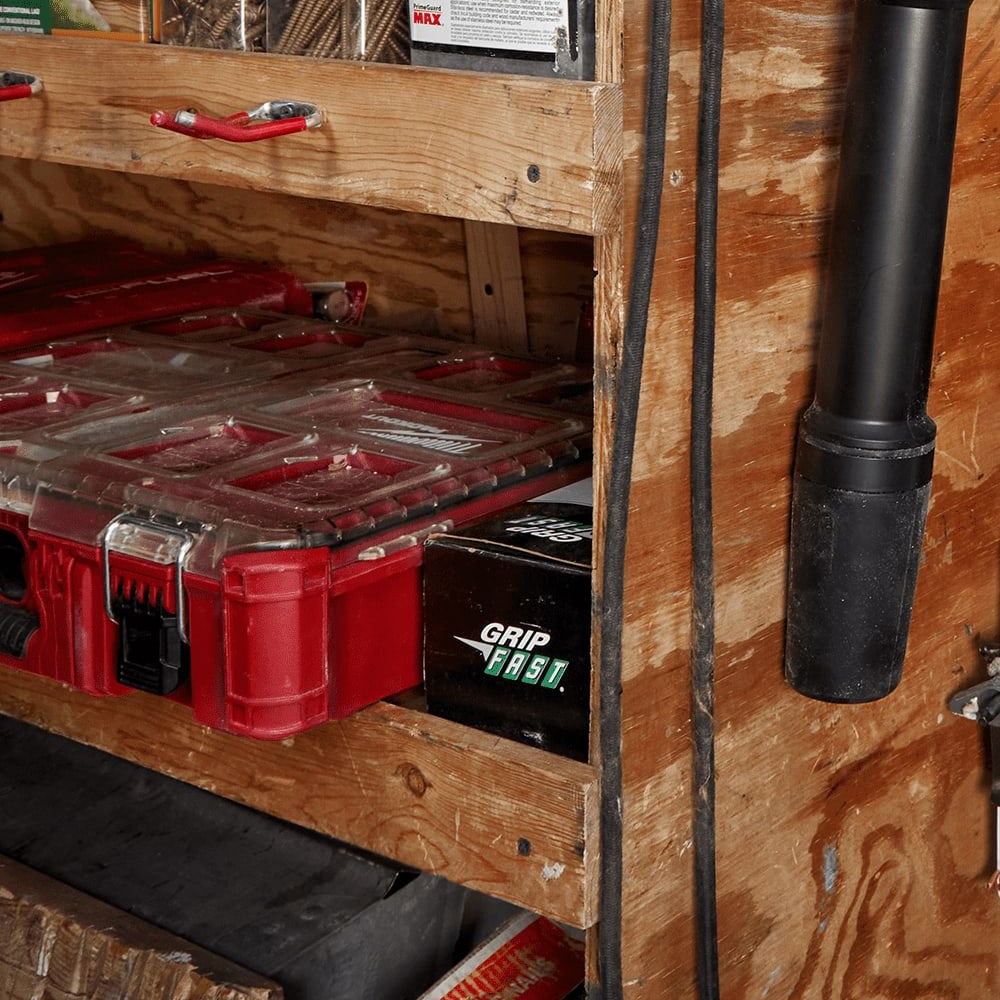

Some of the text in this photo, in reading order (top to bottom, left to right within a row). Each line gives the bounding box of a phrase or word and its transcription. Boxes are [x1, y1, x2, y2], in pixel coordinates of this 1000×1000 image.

[413, 3, 442, 11] PrimeGuard
[414, 12, 442, 26] MAX
[480, 622, 550, 650] GRIP
[487, 647, 568, 686] FAST
